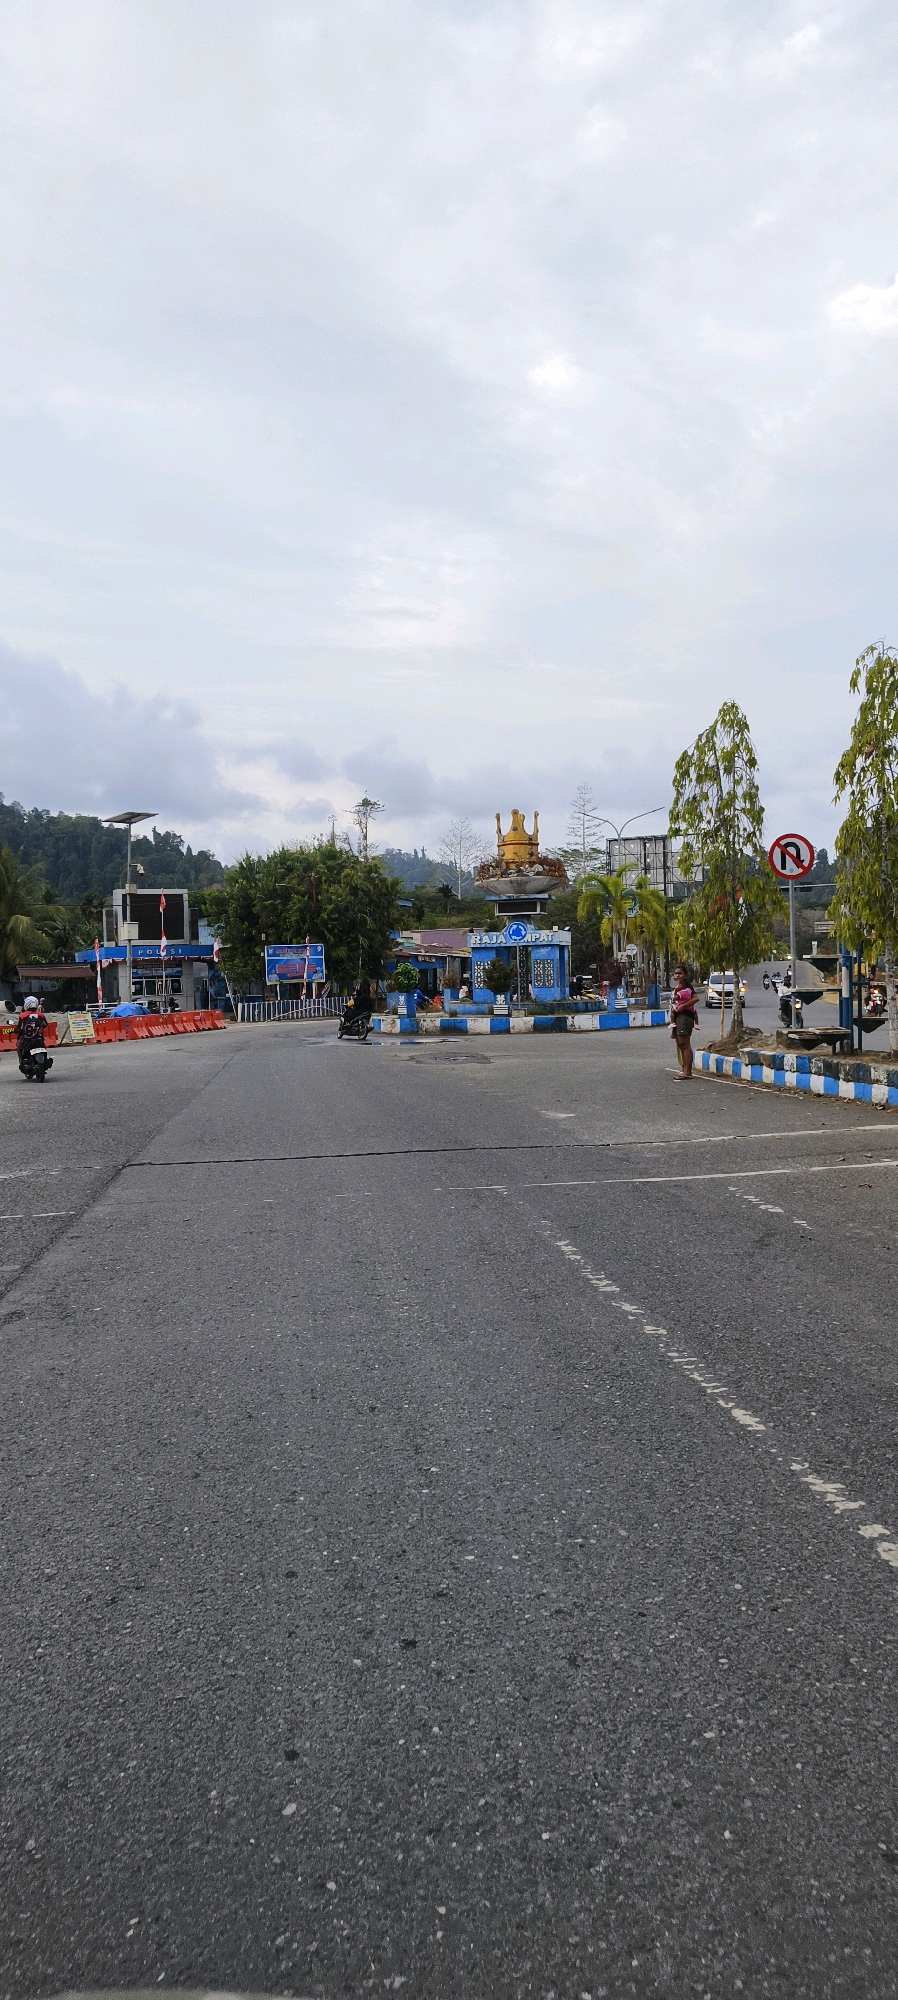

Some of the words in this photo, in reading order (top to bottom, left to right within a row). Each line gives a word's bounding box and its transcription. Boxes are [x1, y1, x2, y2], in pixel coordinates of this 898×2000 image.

[470, 935, 506, 945] RAJA
[511, 932, 554, 943] MPAT
[138, 948, 182, 956] POLSI
